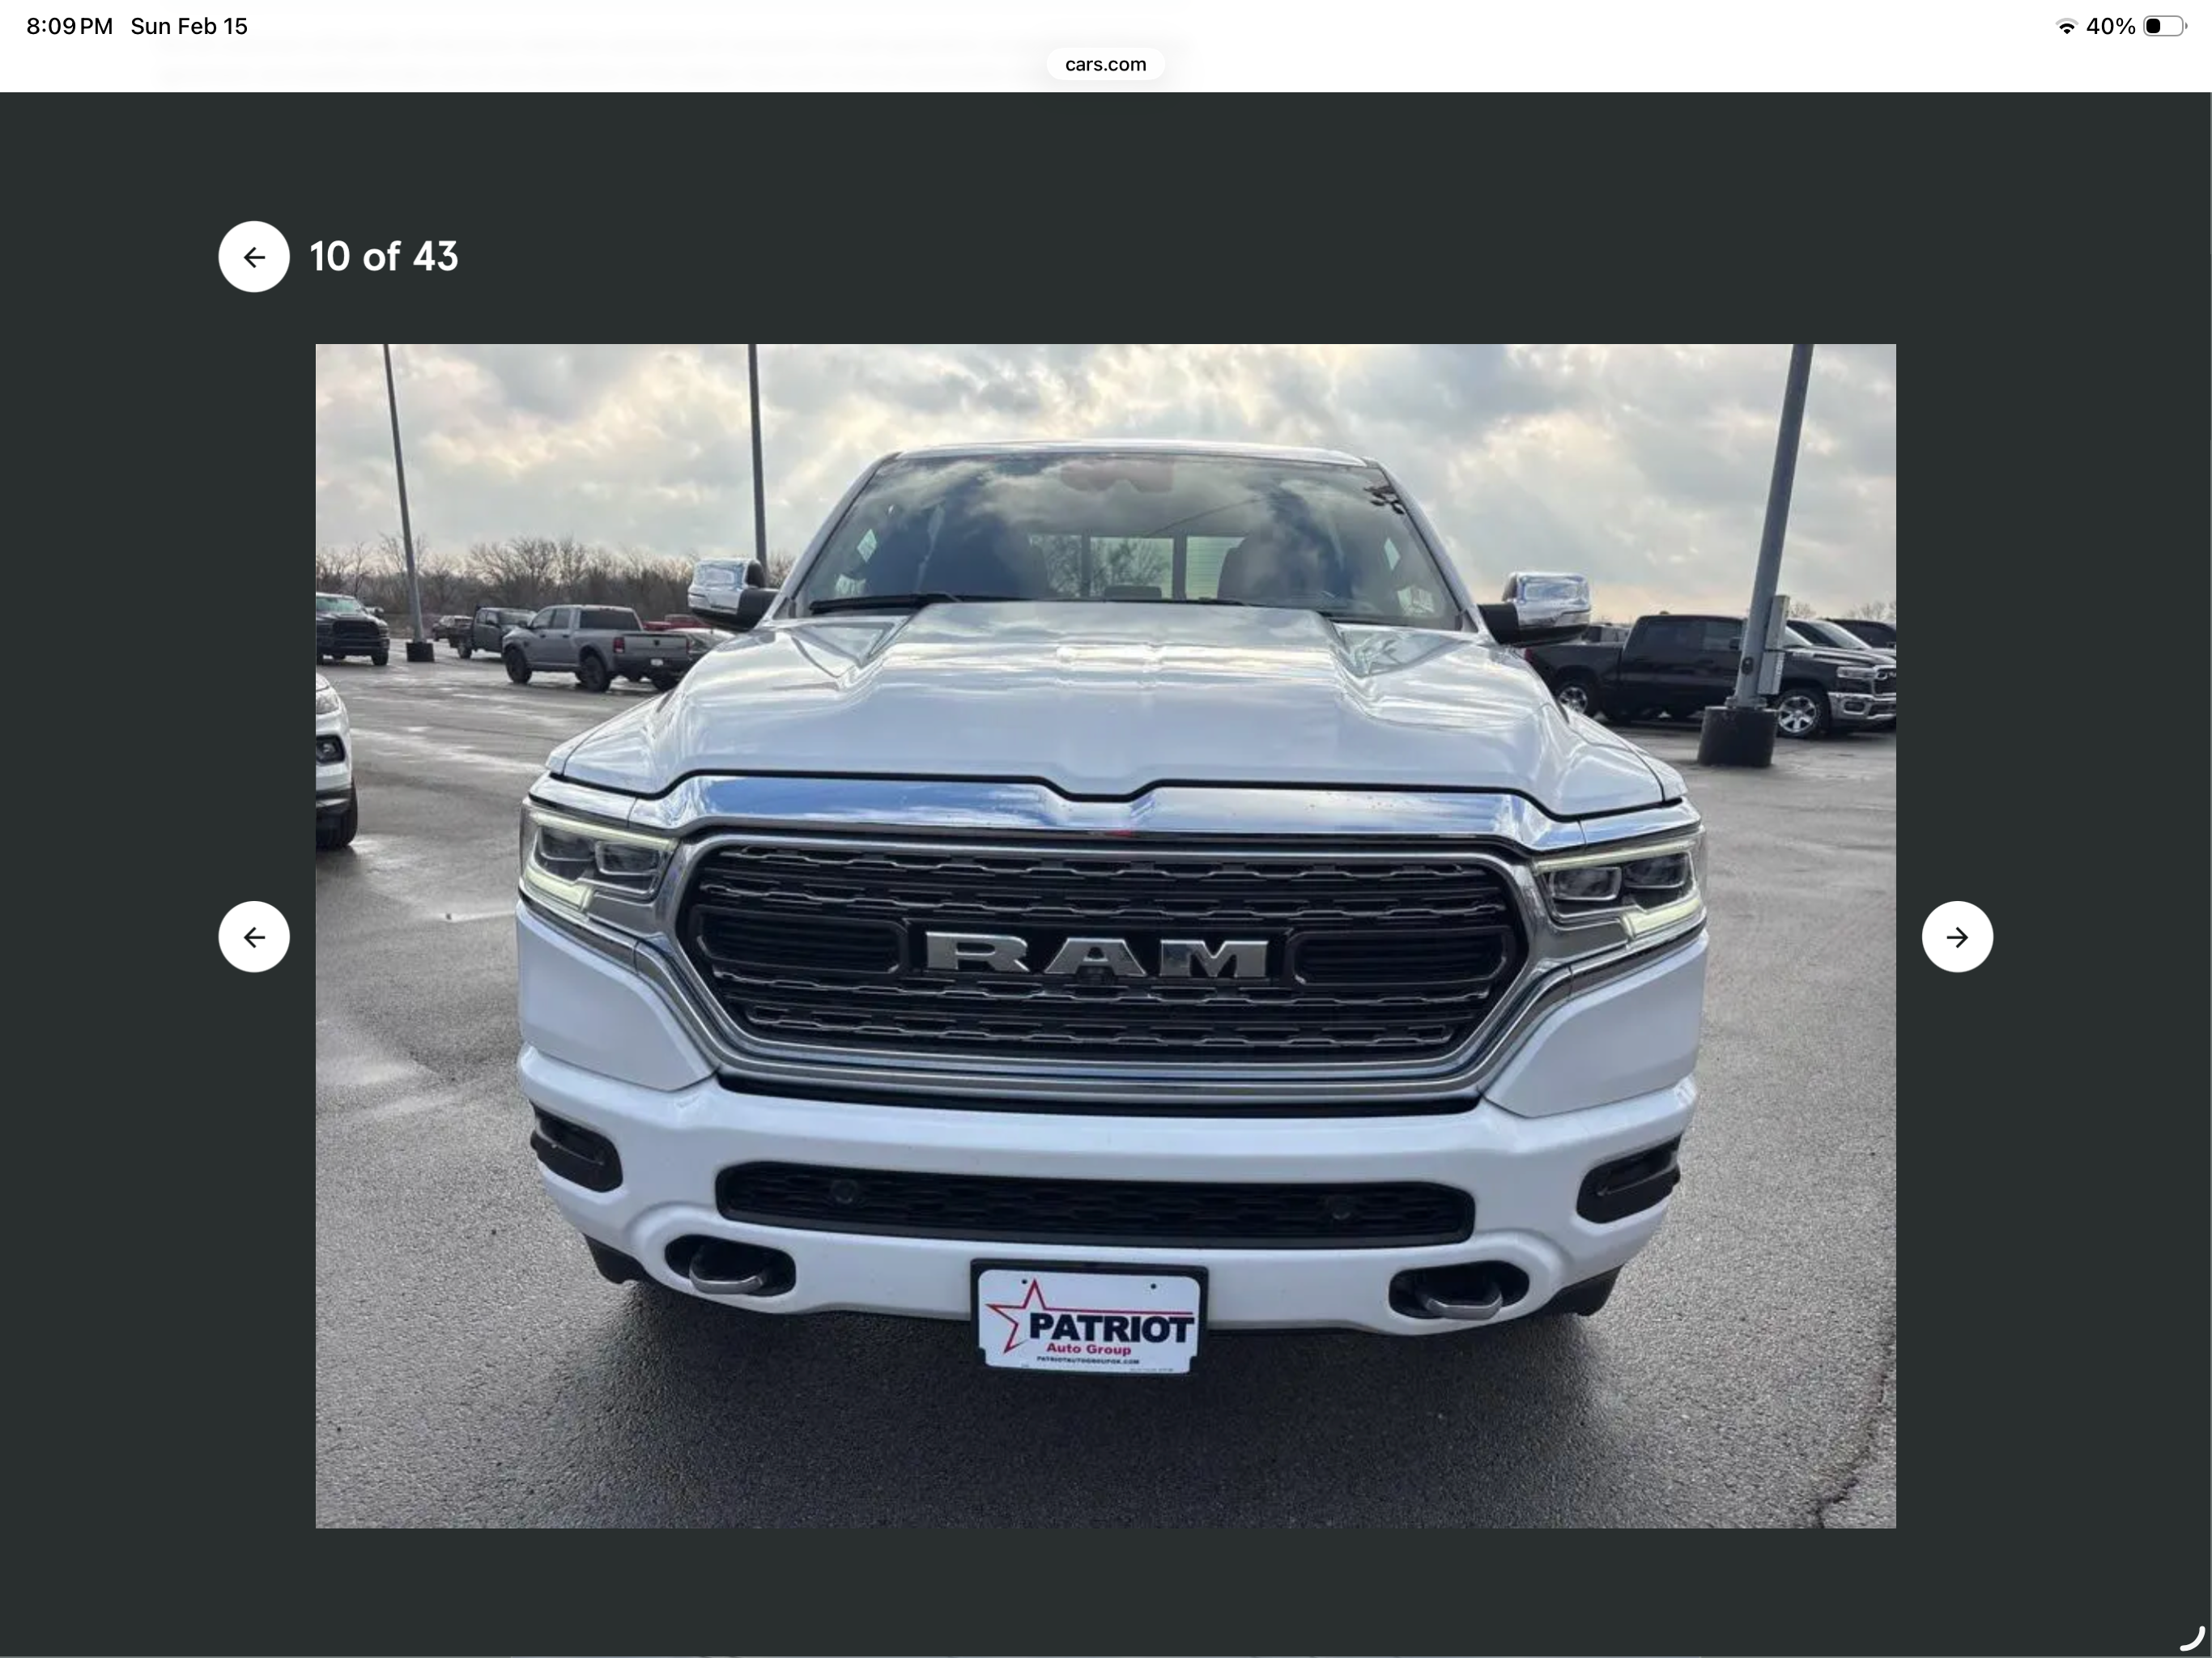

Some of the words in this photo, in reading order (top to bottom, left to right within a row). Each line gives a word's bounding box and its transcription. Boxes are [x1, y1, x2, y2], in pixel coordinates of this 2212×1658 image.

[925, 931, 1269, 978] RAM
[1029, 1312, 1195, 1344] PATRIOT
[1046, 1342, 1082, 1354] Auto
[1086, 1343, 1132, 1356] Group
